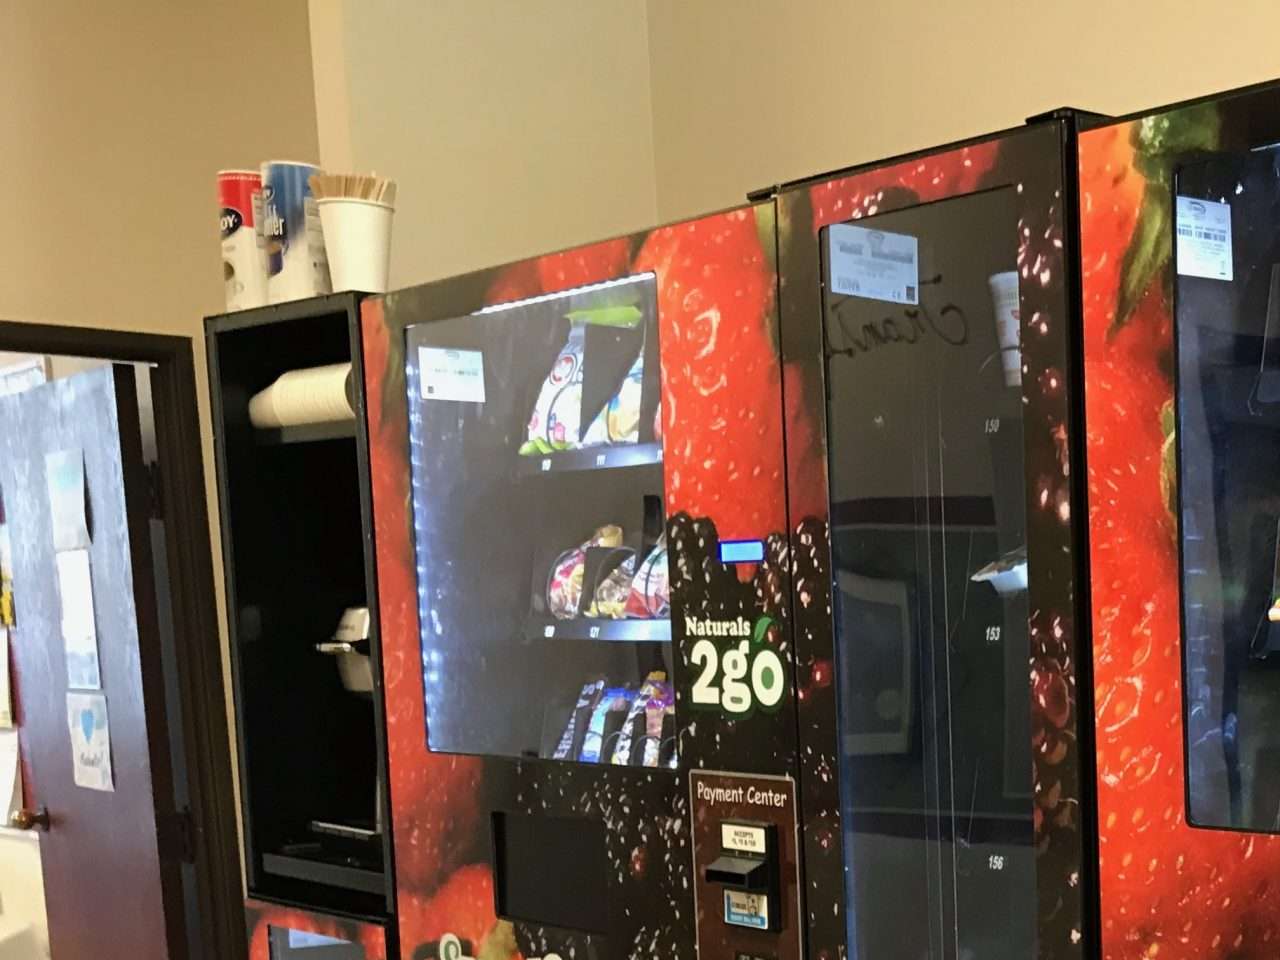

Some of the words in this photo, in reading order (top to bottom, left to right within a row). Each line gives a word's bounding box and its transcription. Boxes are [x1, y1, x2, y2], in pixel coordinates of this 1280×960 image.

[685, 616, 751, 637] Naturals
[985, 626, 1000, 642] 153
[691, 639, 784, 713] 2go
[697, 781, 744, 806] Payment
[747, 786, 788, 807] Center
[988, 855, 1004, 871] 156
